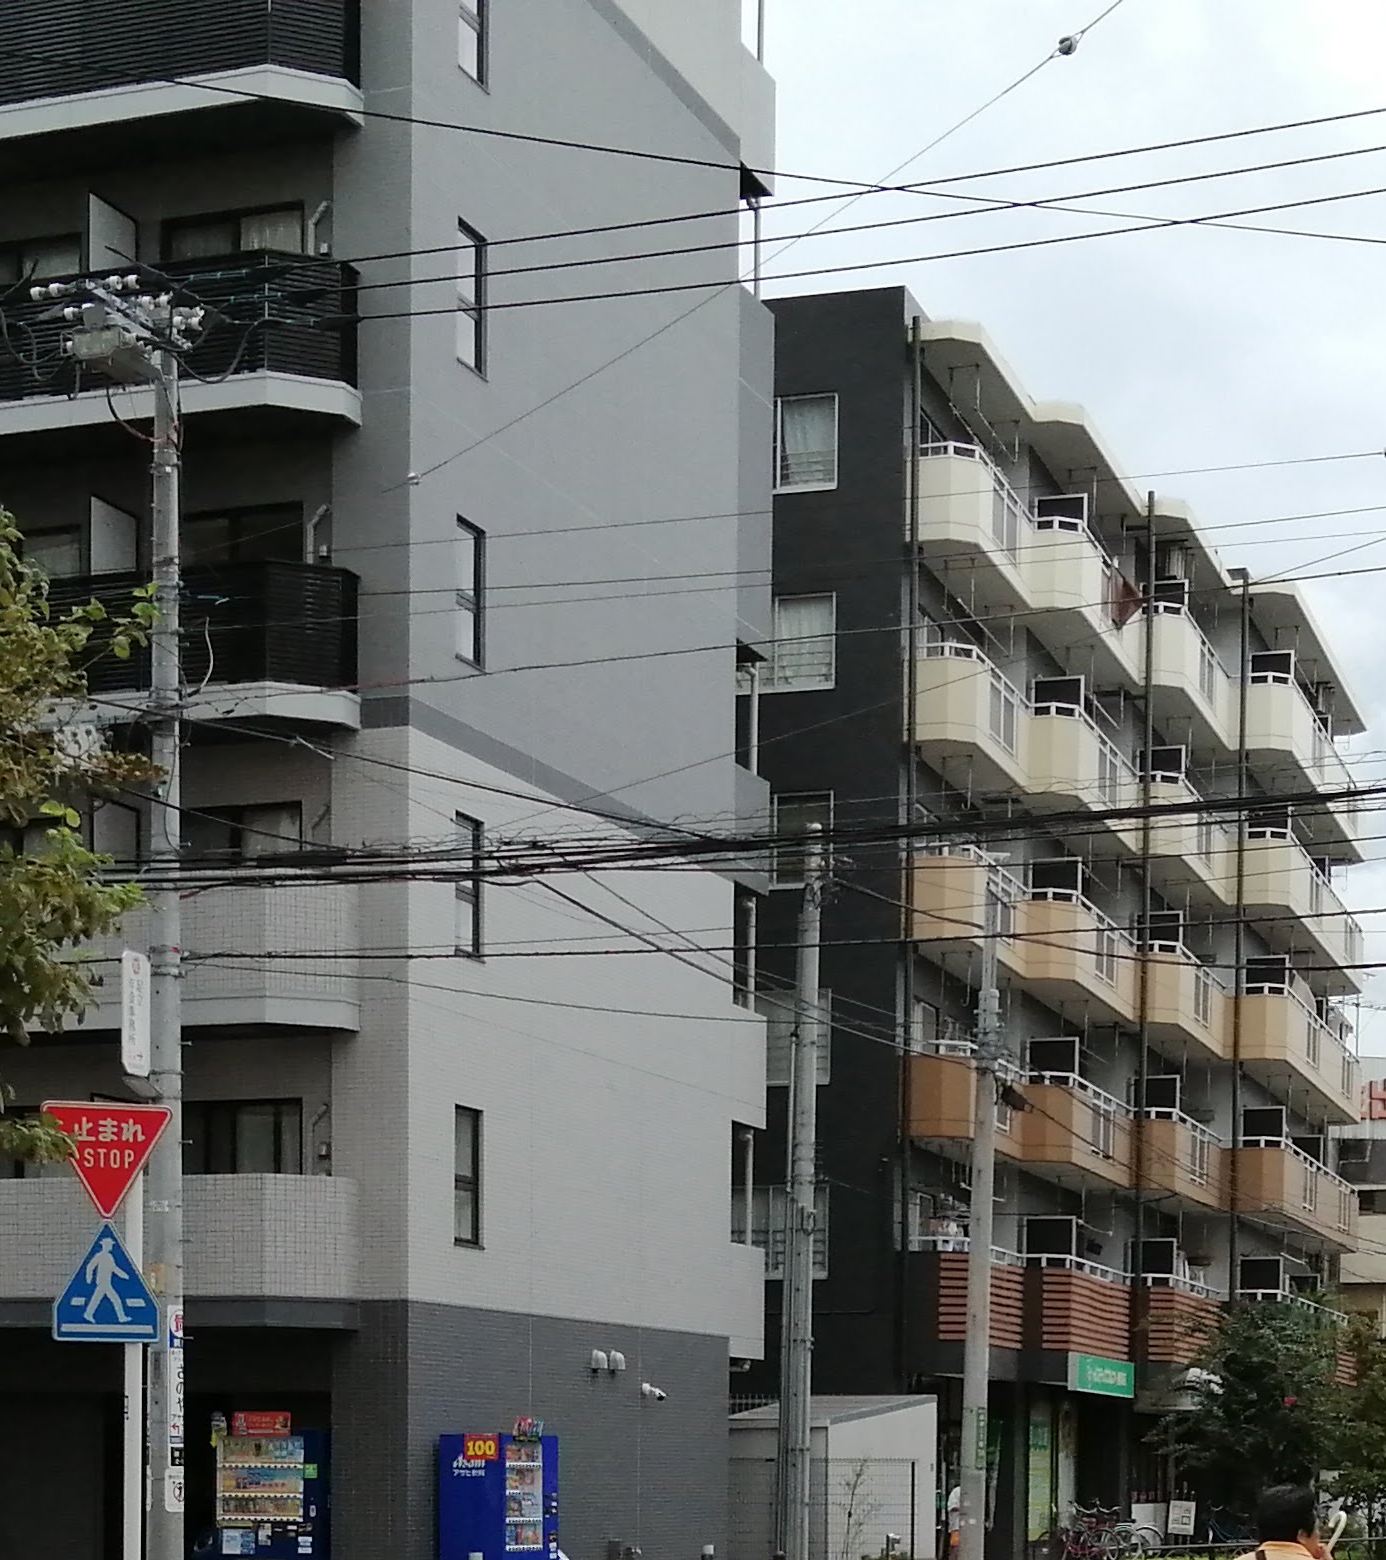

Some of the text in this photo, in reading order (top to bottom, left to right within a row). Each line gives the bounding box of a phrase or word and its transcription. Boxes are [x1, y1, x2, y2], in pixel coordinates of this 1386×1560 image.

[73, 1117, 146, 1142] 止まれ
[83, 1149, 135, 1169] STOP
[467, 1440, 496, 1456] 100
